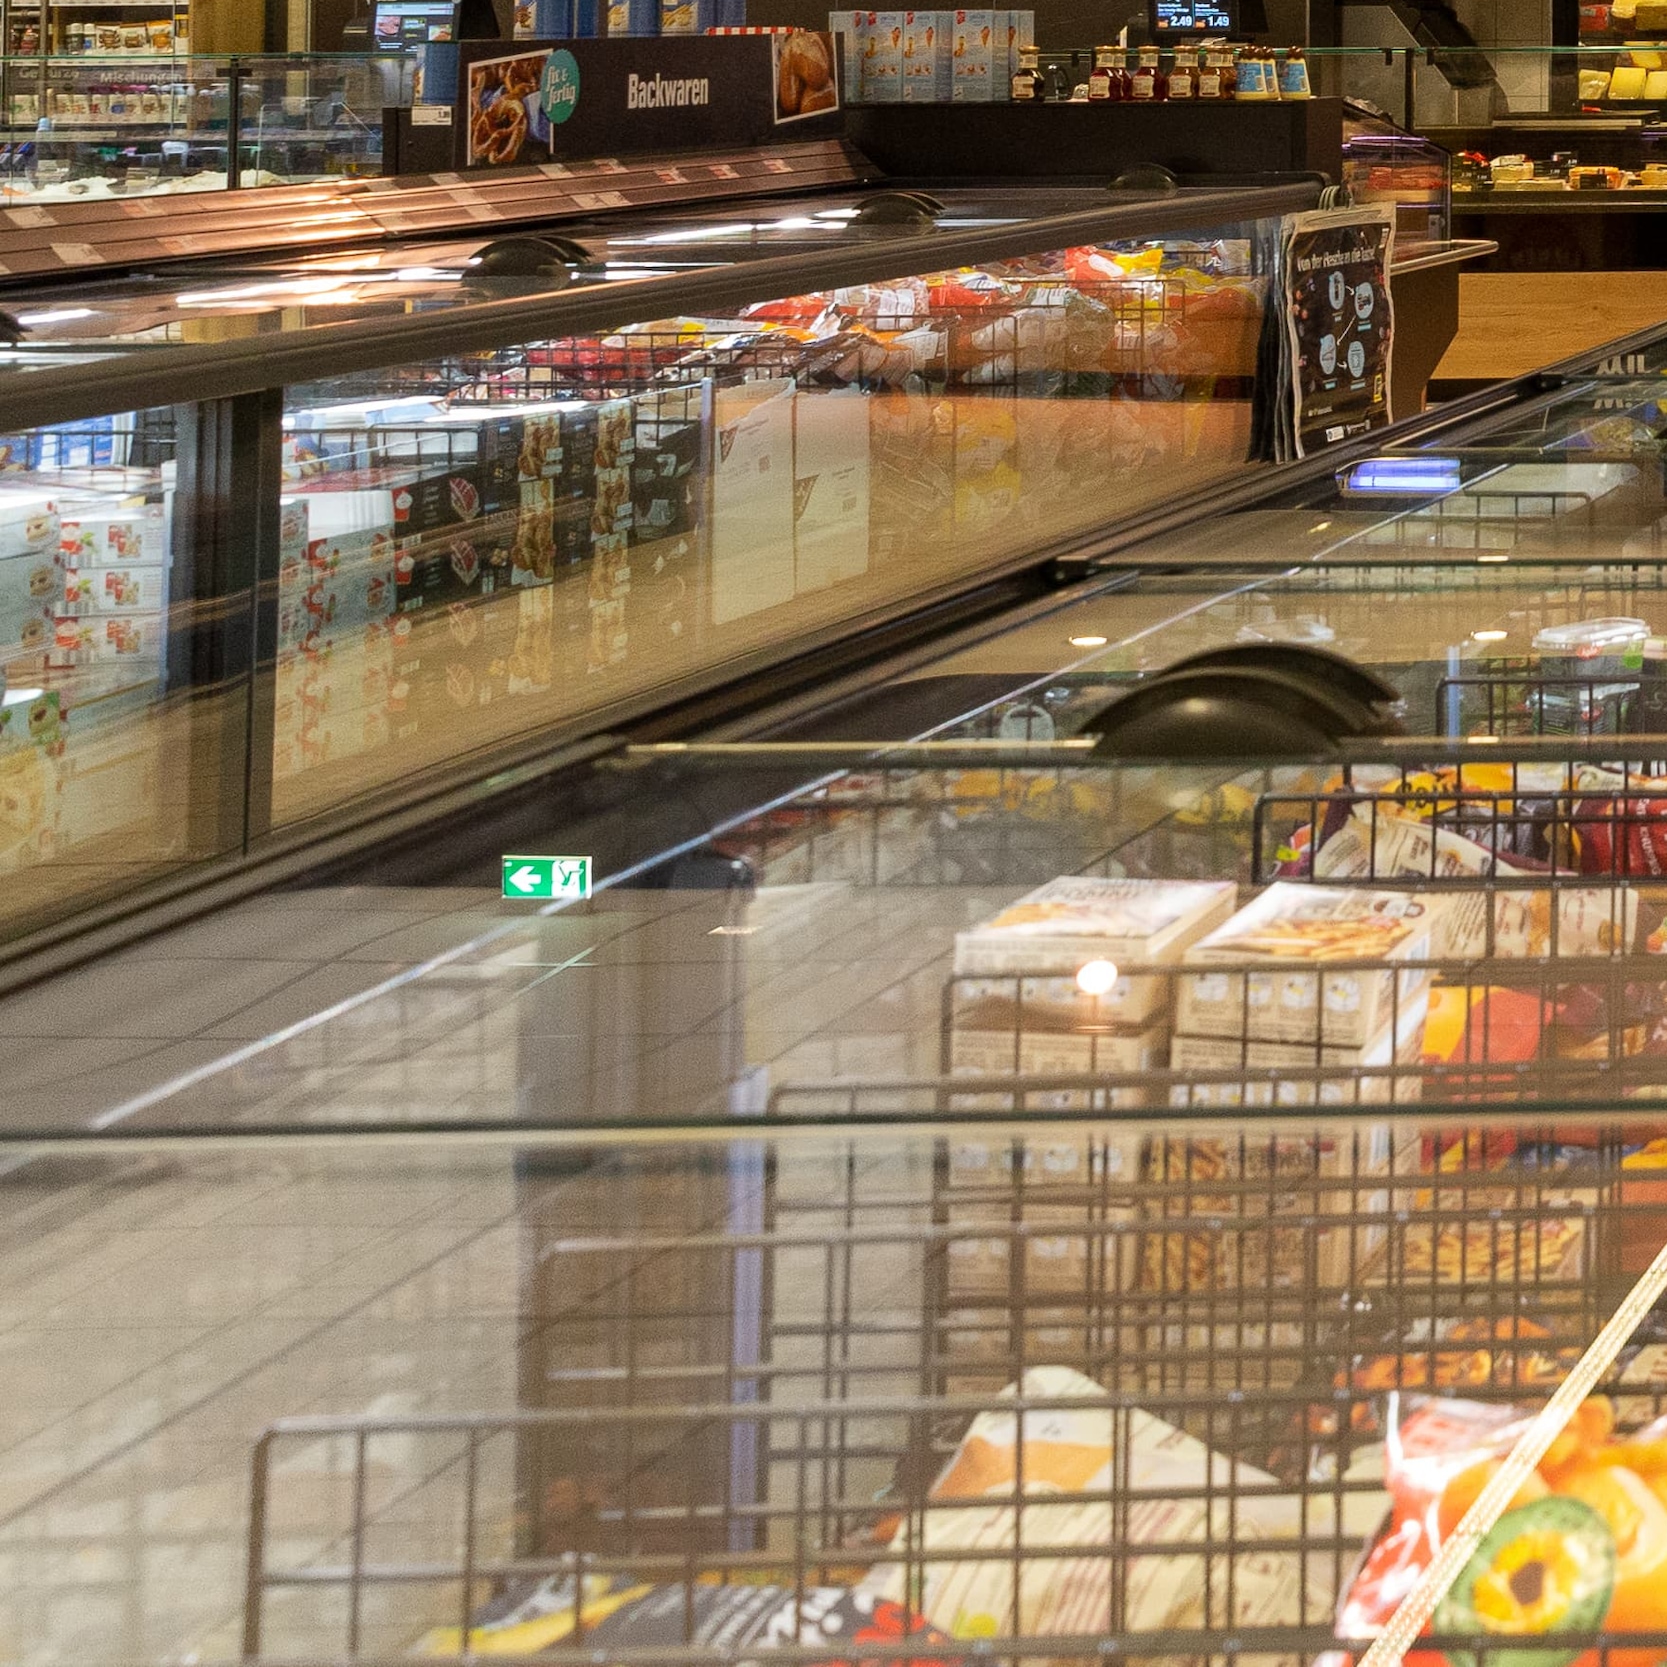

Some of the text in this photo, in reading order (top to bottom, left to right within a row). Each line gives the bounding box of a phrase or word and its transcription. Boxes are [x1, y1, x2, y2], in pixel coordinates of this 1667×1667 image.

[1170, 15, 1193, 27] 2.49
[1207, 15, 1230, 27] 1.49
[627, 73, 709, 110] Backwaren
